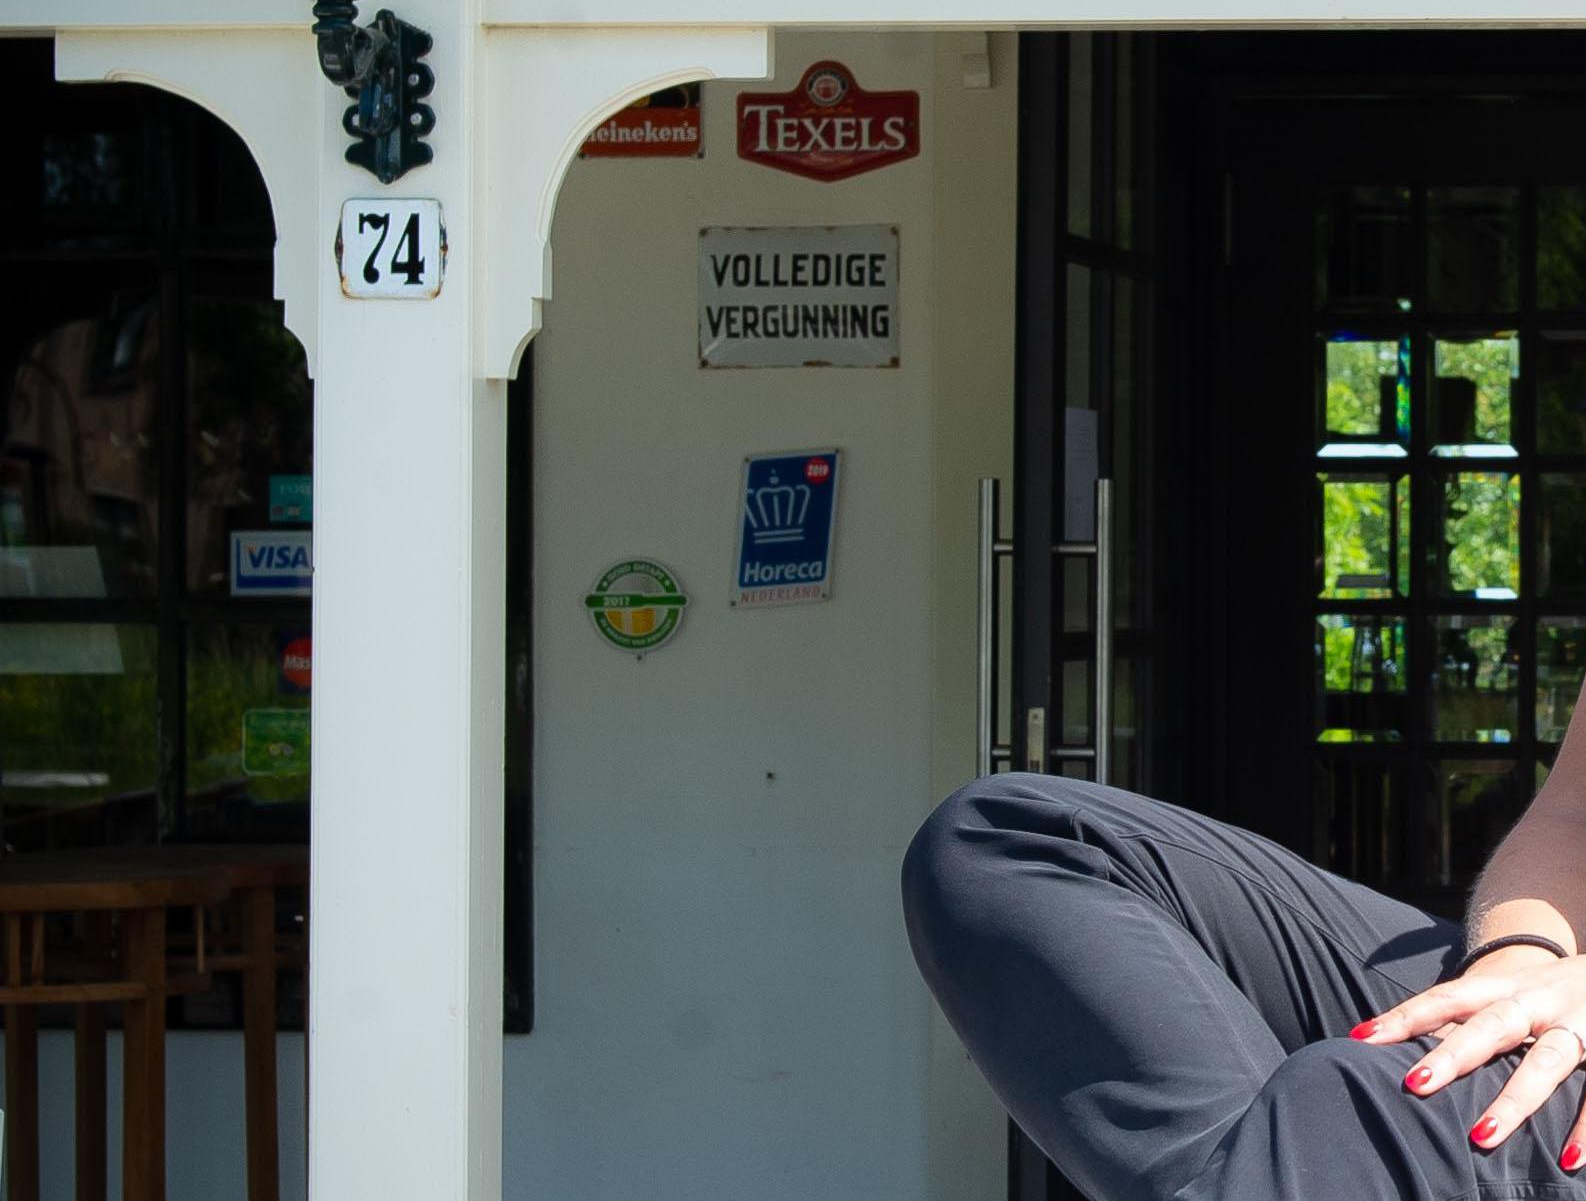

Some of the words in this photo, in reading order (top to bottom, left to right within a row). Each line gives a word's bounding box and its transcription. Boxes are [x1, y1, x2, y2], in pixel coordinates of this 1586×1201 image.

[743, 104, 907, 152] TEXELS
[357, 212, 426, 285] 74
[710, 253, 887, 288] VOLLEDIGE
[705, 304, 890, 339] VERGUNNING
[247, 545, 310, 569] VISA
[743, 560, 823, 584] Horeca
[739, 585, 822, 604] NEDERLAND
